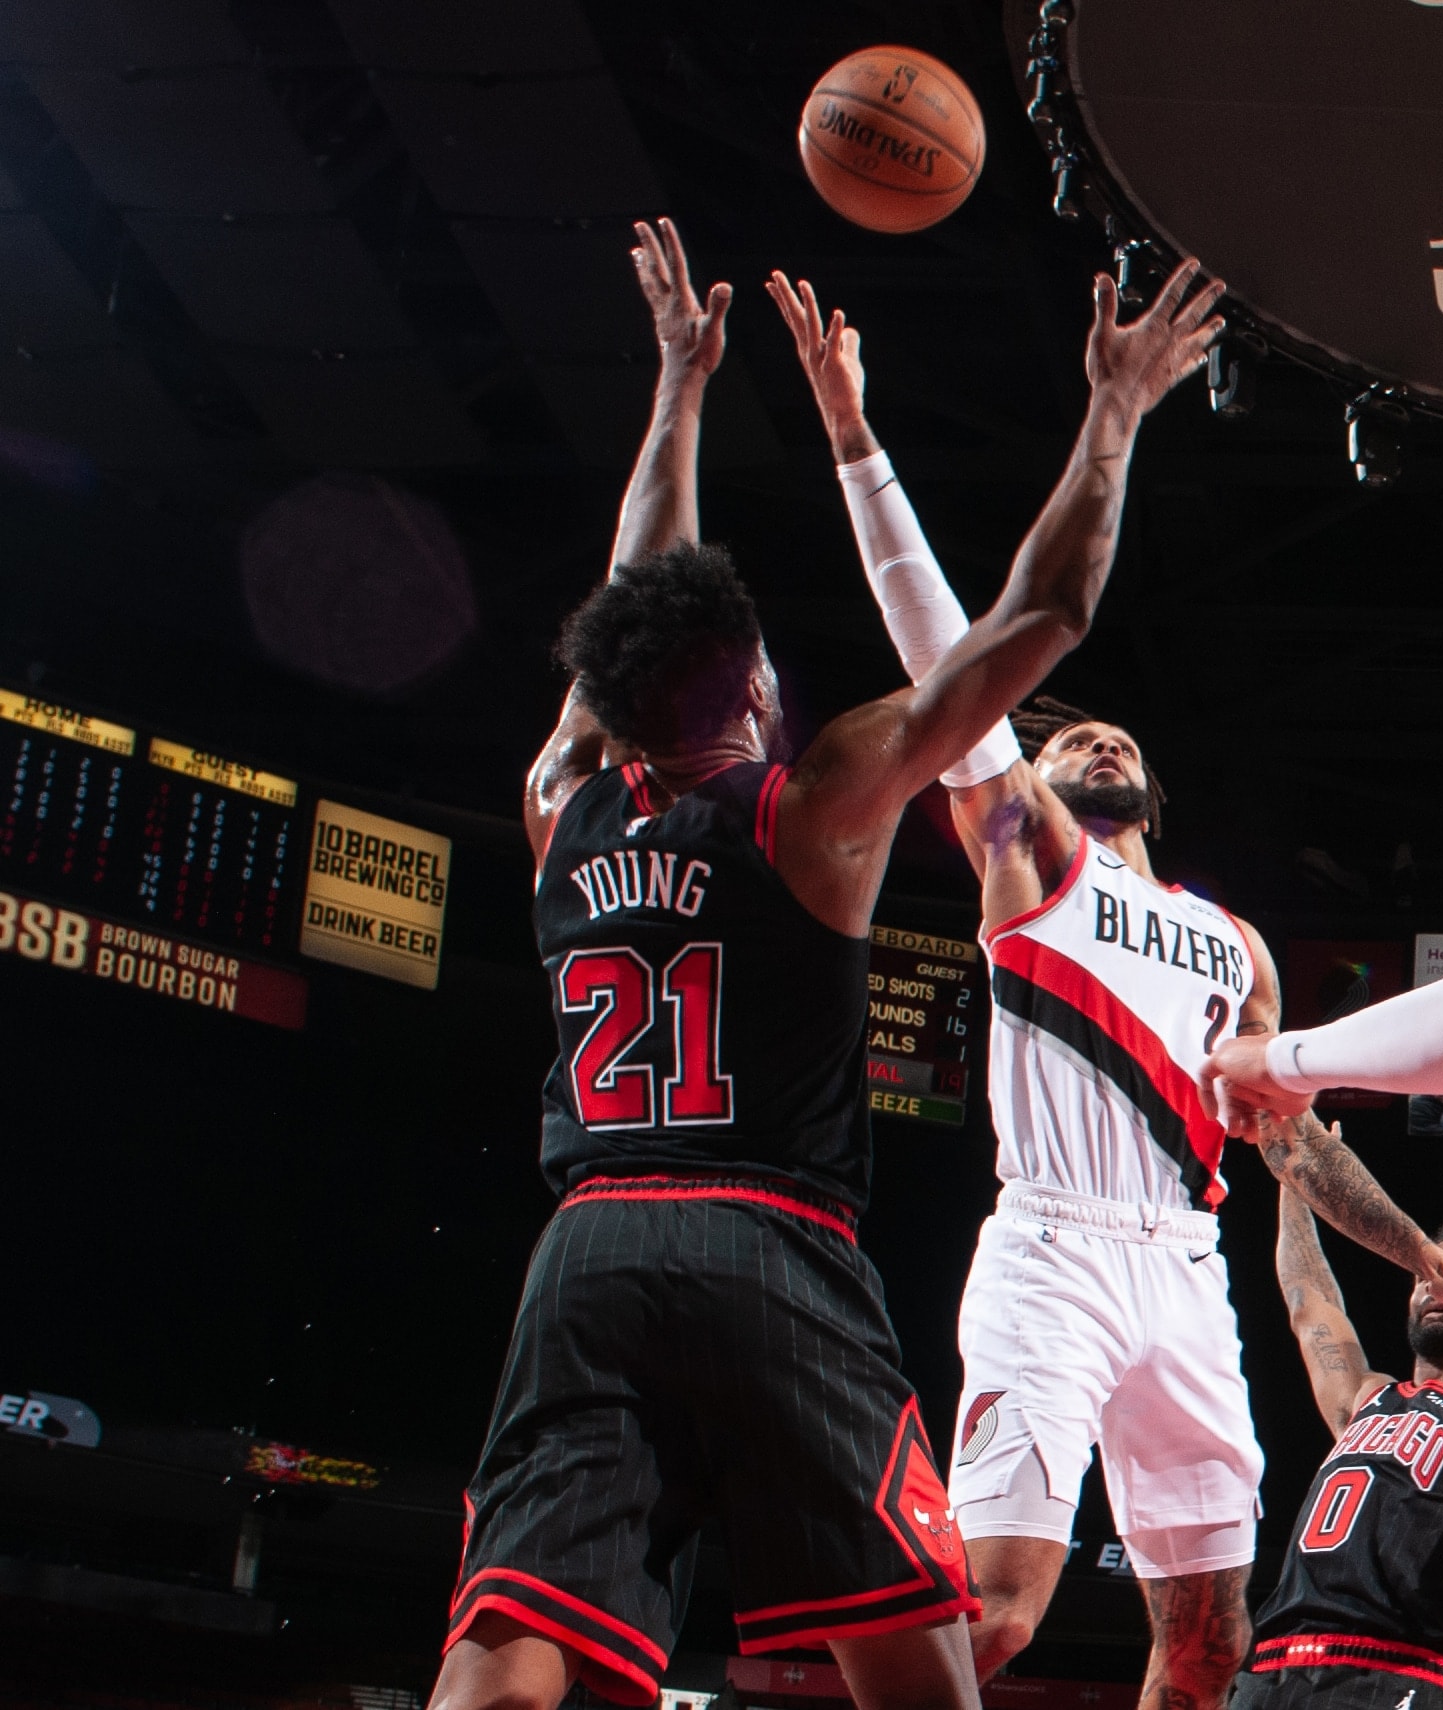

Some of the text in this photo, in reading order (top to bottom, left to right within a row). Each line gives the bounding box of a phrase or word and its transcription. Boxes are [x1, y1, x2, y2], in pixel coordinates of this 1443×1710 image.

[817, 99, 943, 177] SPALDING
[25, 698, 91, 728] HOME
[192, 750, 256, 781] GUEST
[314, 849, 415, 899] BREWING
[317, 820, 445, 884] 10 BARREL
[570, 850, 712, 920] YOUNG
[100, 922, 240, 979] BROWN SUGAR
[308, 901, 376, 941] DRINK
[377, 921, 437, 958] BEER
[1090, 885, 1244, 996] BLAZERS
[96, 947, 238, 1011] BOURBON
[889, 978, 935, 1001] SHOTS
[956, 989, 970, 1008] 2
[917, 963, 966, 981] GUEST
[559, 942, 734, 1132] 21
[946, 1016, 966, 1036] 16
[960, 1046, 966, 1062] 1
[1299, 1466, 1375, 1553] 0
